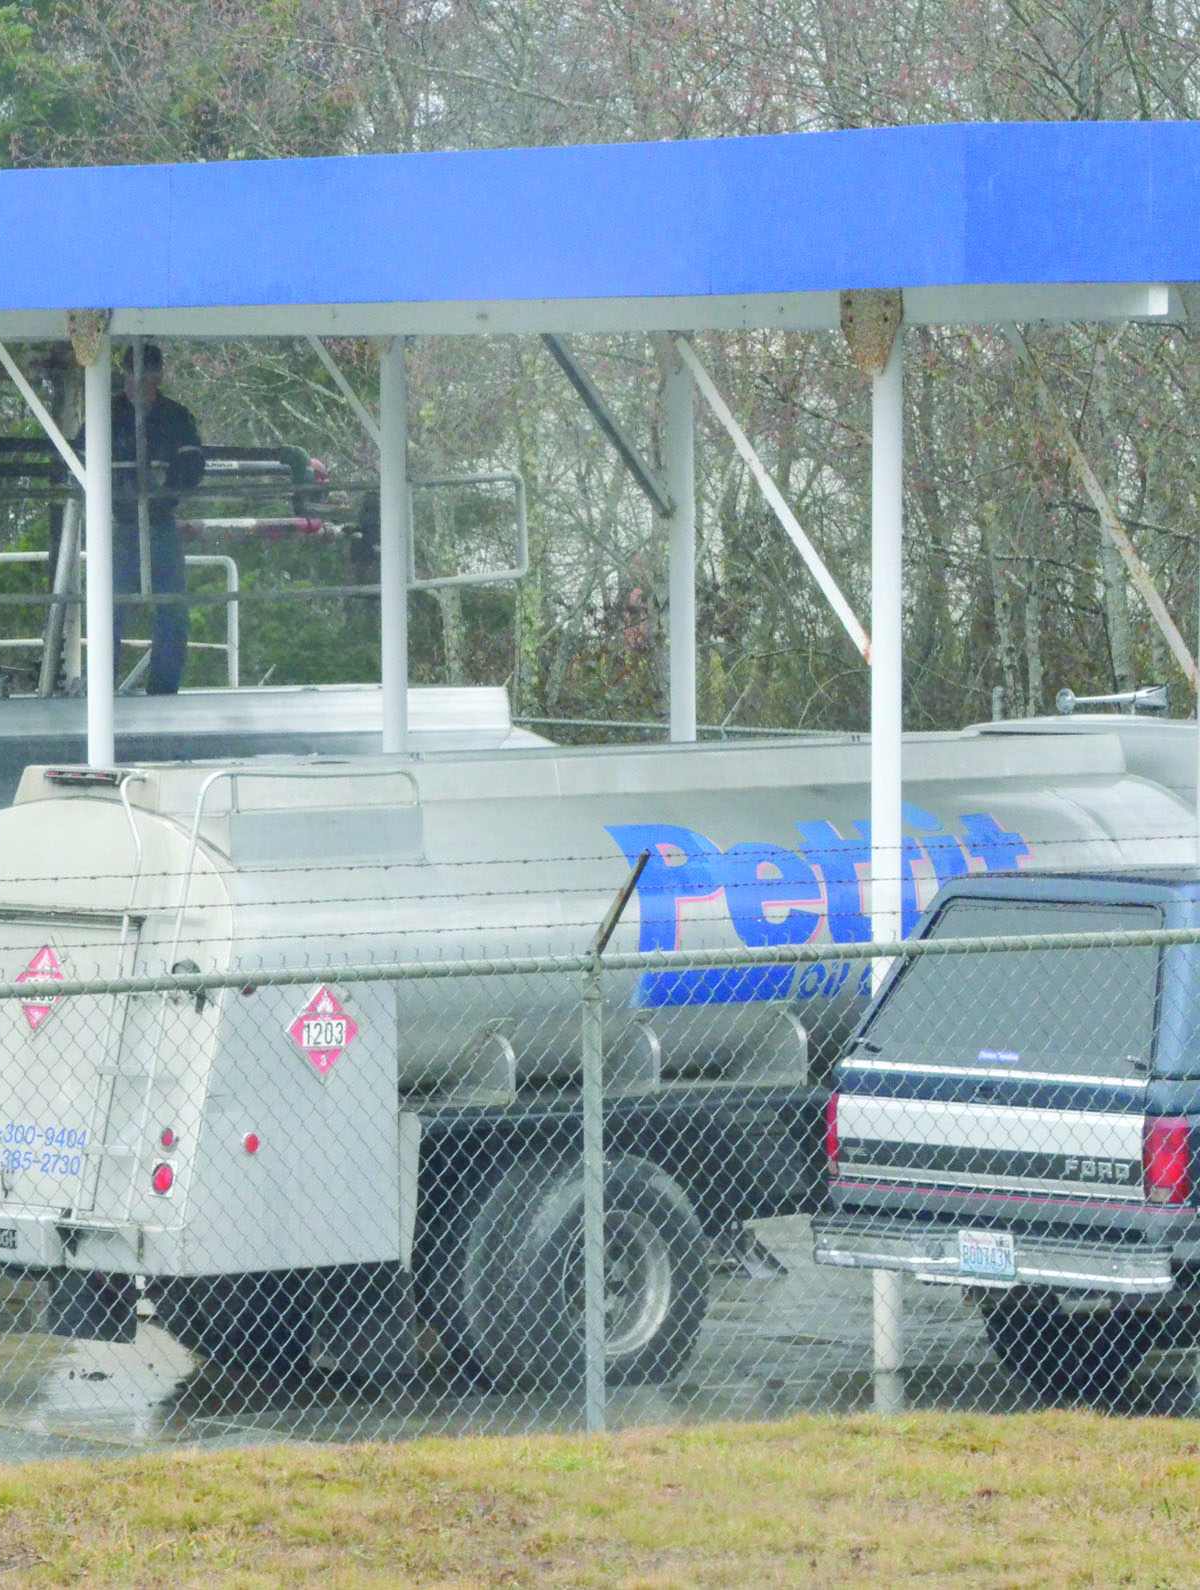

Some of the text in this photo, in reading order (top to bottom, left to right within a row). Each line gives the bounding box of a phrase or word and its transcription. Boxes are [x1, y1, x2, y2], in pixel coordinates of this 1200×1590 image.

[798, 961, 851, 998] Oil
[304, 1022, 344, 1045] 1203
[320, 1054, 327, 1066] 3
[1064, 1159, 1130, 1180] FORD
